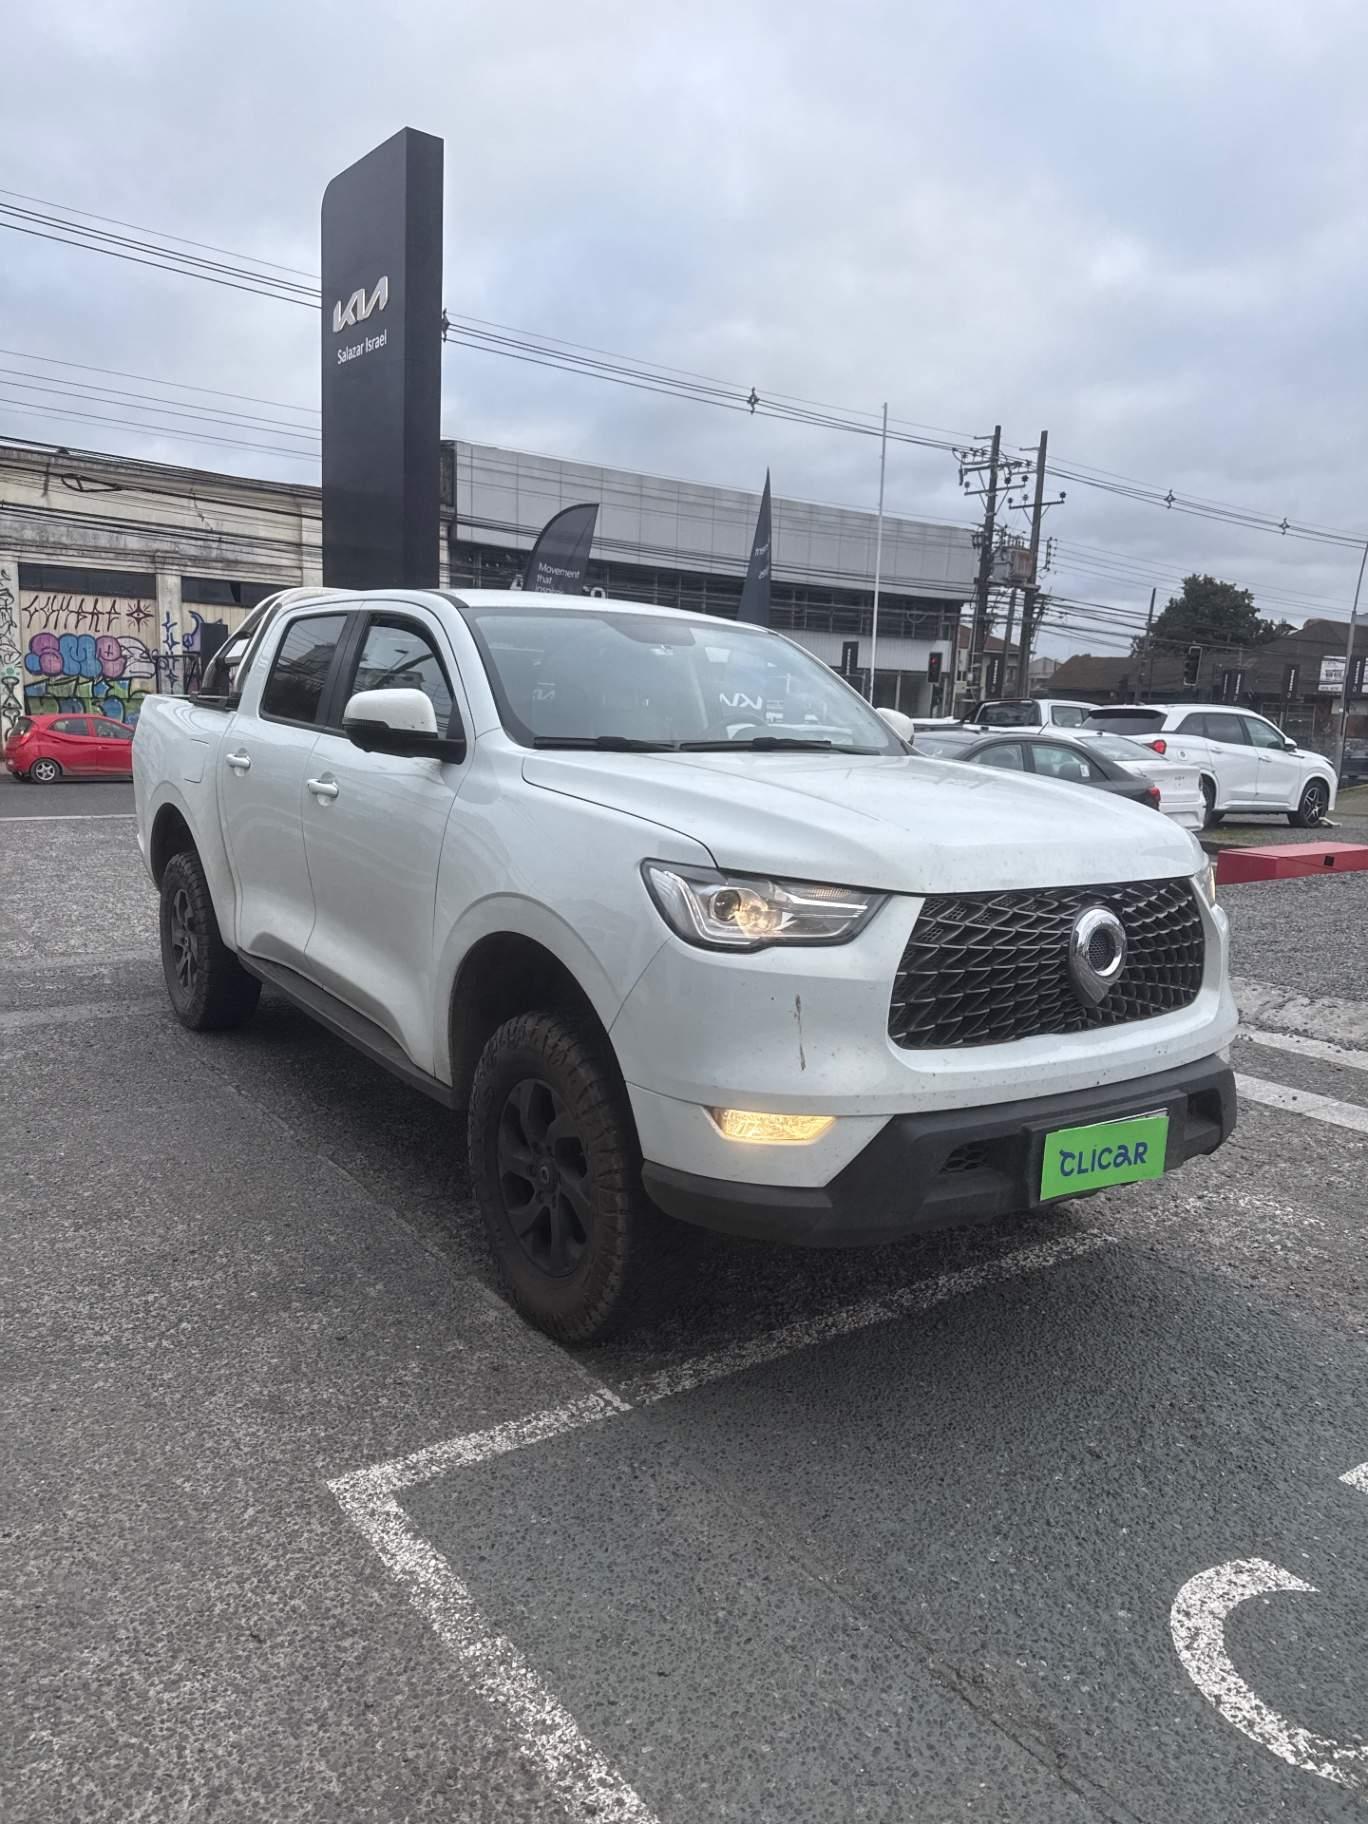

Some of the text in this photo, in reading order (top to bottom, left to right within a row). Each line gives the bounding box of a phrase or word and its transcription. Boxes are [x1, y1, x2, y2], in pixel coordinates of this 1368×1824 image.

[332, 275, 388, 333] KIA
[337, 328, 387, 365] Salazar Israel
[536, 573, 553, 585] that
[538, 562, 580, 579] Movement
